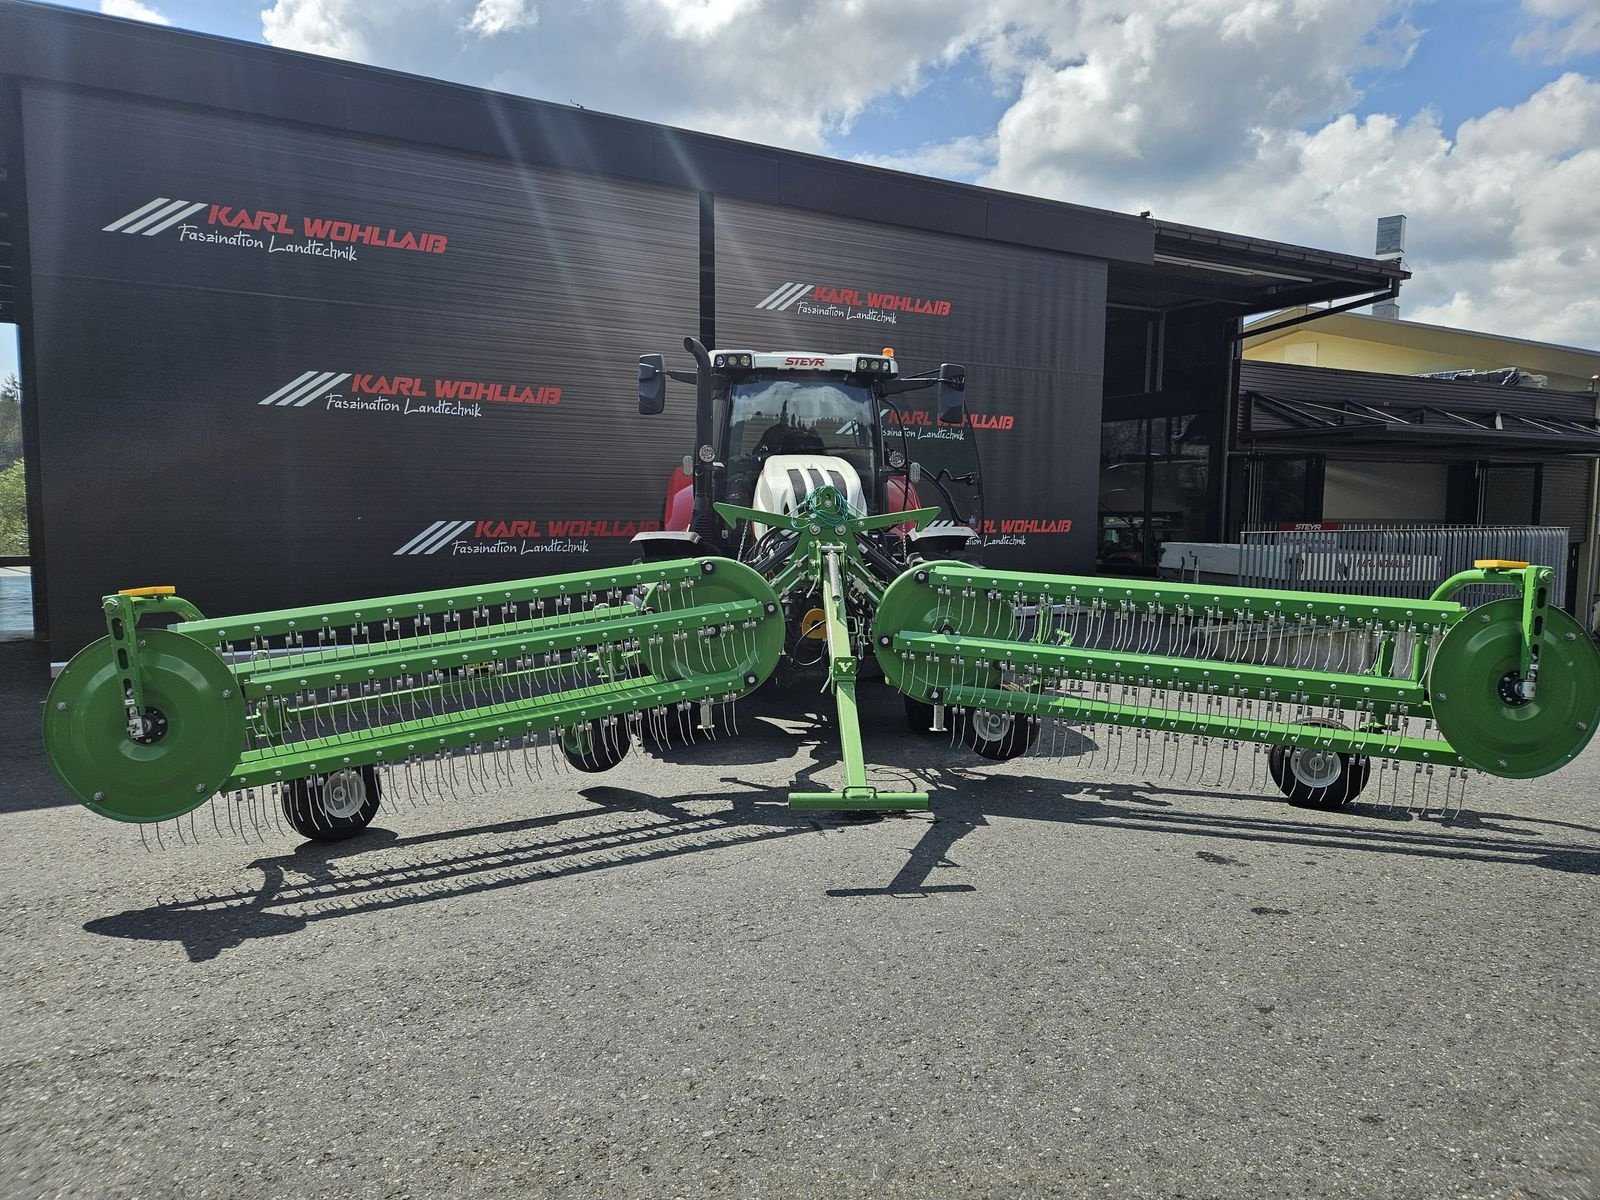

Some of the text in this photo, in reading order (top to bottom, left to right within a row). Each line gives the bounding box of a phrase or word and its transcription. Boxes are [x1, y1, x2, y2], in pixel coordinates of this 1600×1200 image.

[208, 204, 294, 234] KARL
[177, 223, 358, 262] Faszination Landtechnik
[813, 285, 863, 305] KARL
[797, 301, 897, 325] Faszination Landtechnik
[785, 357, 825, 367] STEYR
[352, 373, 427, 396] KARL
[324, 393, 482, 417] Faszination Landtechnik
[917, 426, 965, 441] Landtechnik
[475, 521, 541, 538] KARL
[1295, 523, 1322, 531] STEYR
[451, 539, 589, 556] Faszination Landtechnik
[983, 534, 1026, 547] Landtechnik
